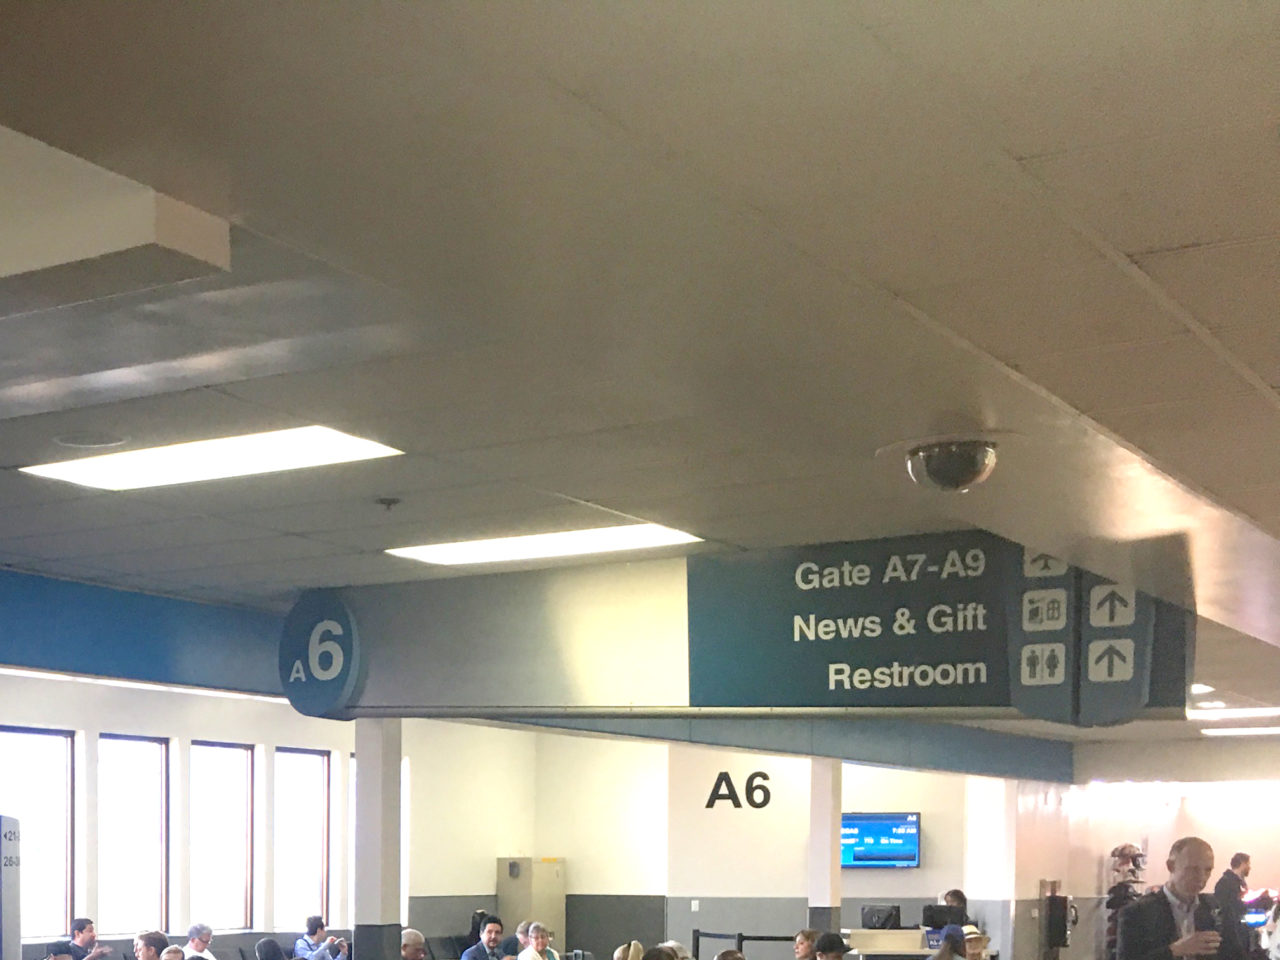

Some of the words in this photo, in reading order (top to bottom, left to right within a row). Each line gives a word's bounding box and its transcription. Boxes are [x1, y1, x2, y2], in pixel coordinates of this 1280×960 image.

[795, 560, 871, 590] Gate
[882, 548, 986, 584] A7-A9
[793, 614, 883, 642] News
[892, 607, 916, 636] &
[926, 602, 987, 634] Gift
[828, 661, 987, 690] Restroom
[705, 771, 772, 808] A6
